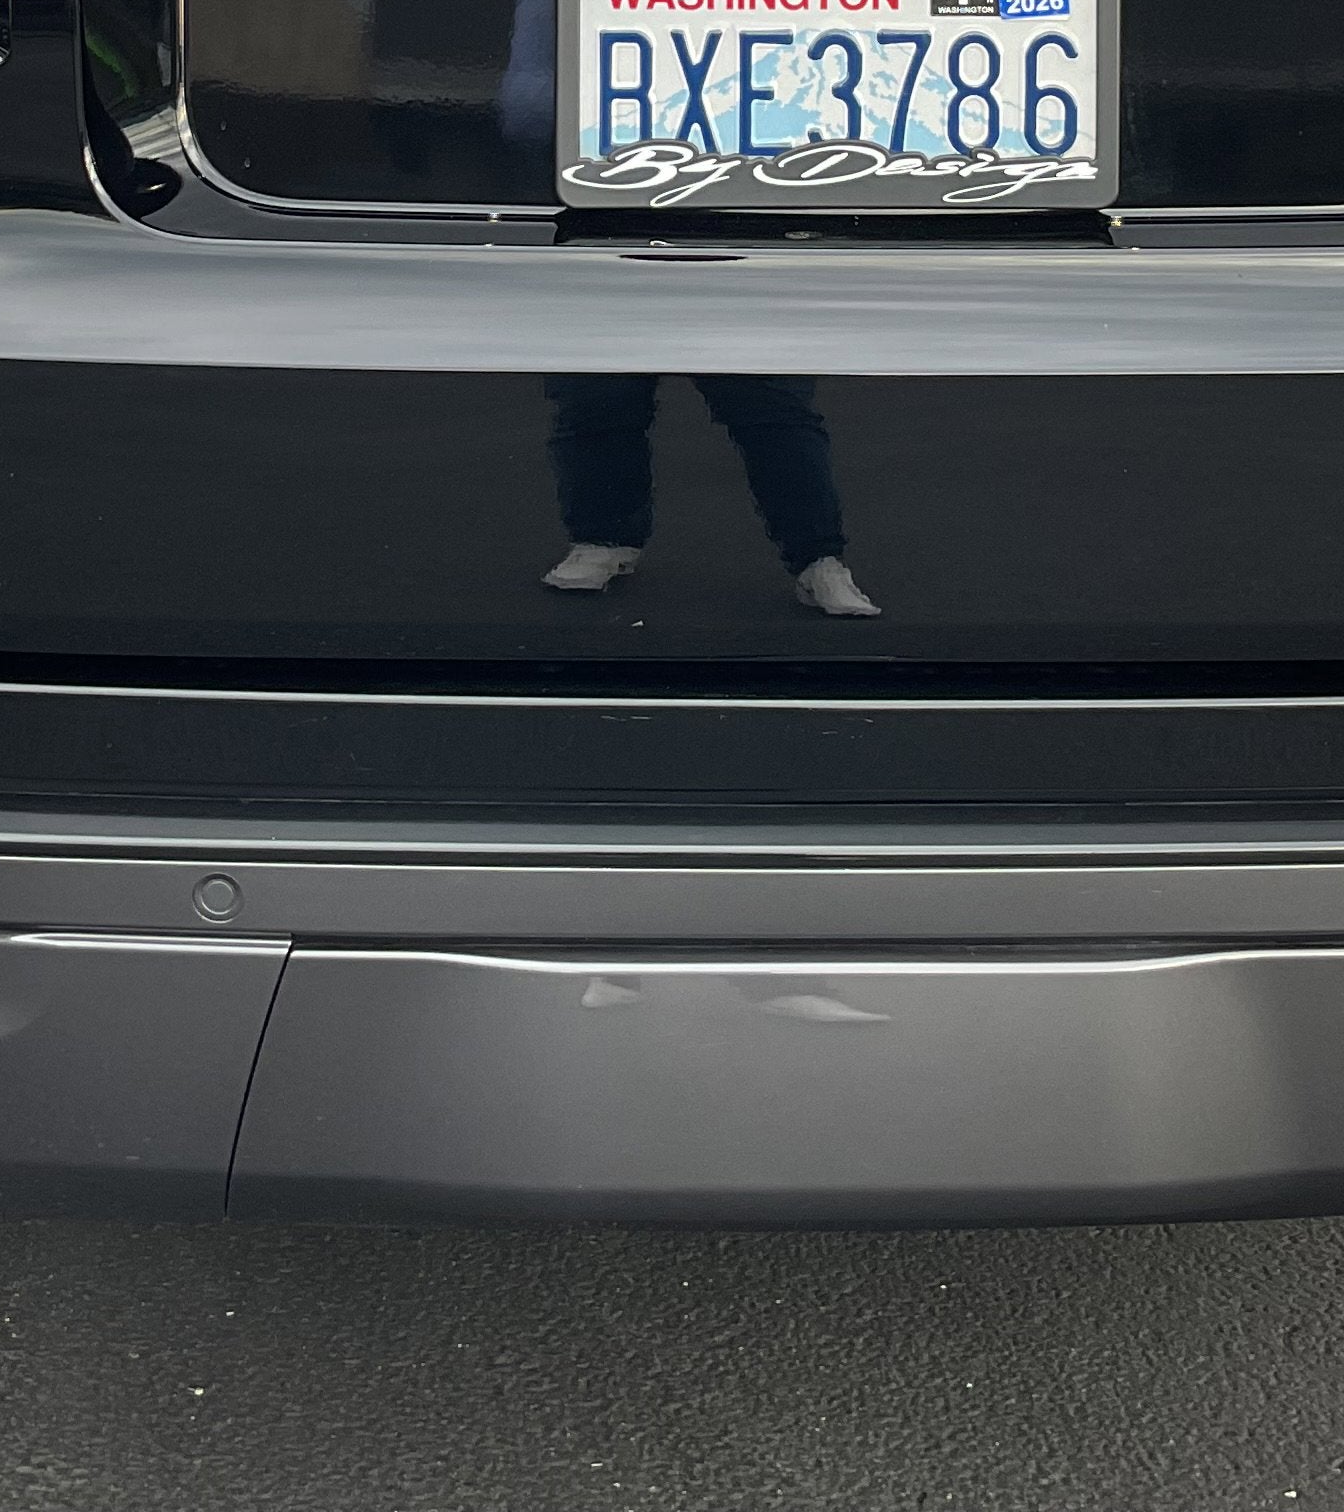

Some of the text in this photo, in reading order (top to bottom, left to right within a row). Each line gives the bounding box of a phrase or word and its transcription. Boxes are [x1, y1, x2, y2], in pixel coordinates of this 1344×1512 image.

[937, 5, 994, 14] WASHINGTON
[599, 32, 1078, 156] BXE3786
[562, 144, 1099, 207] By Design
